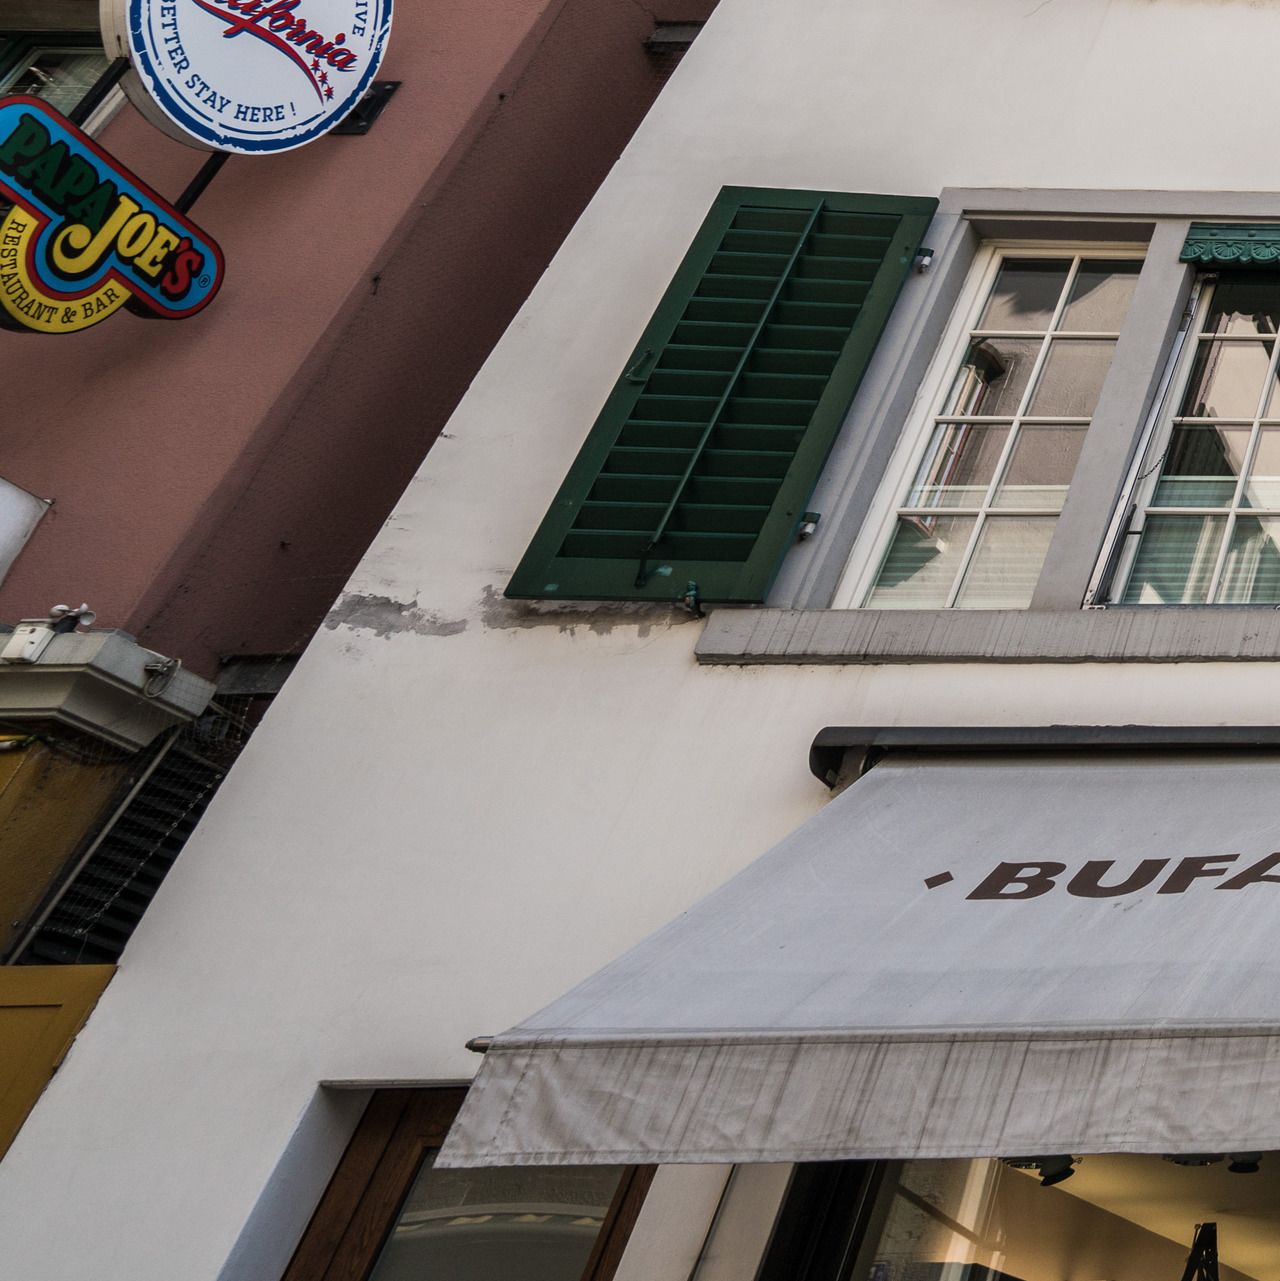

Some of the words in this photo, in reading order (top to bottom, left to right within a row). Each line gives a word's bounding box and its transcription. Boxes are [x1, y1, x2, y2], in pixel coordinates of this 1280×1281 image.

[185, 73, 232, 113] STAY
[0, 113, 118, 233] PAPA
[0, 218, 59, 324] RESTAURANT
[60, 306, 78, 324] &
[82, 287, 120, 319] BAR
[52, 193, 204, 300] JOE'S
